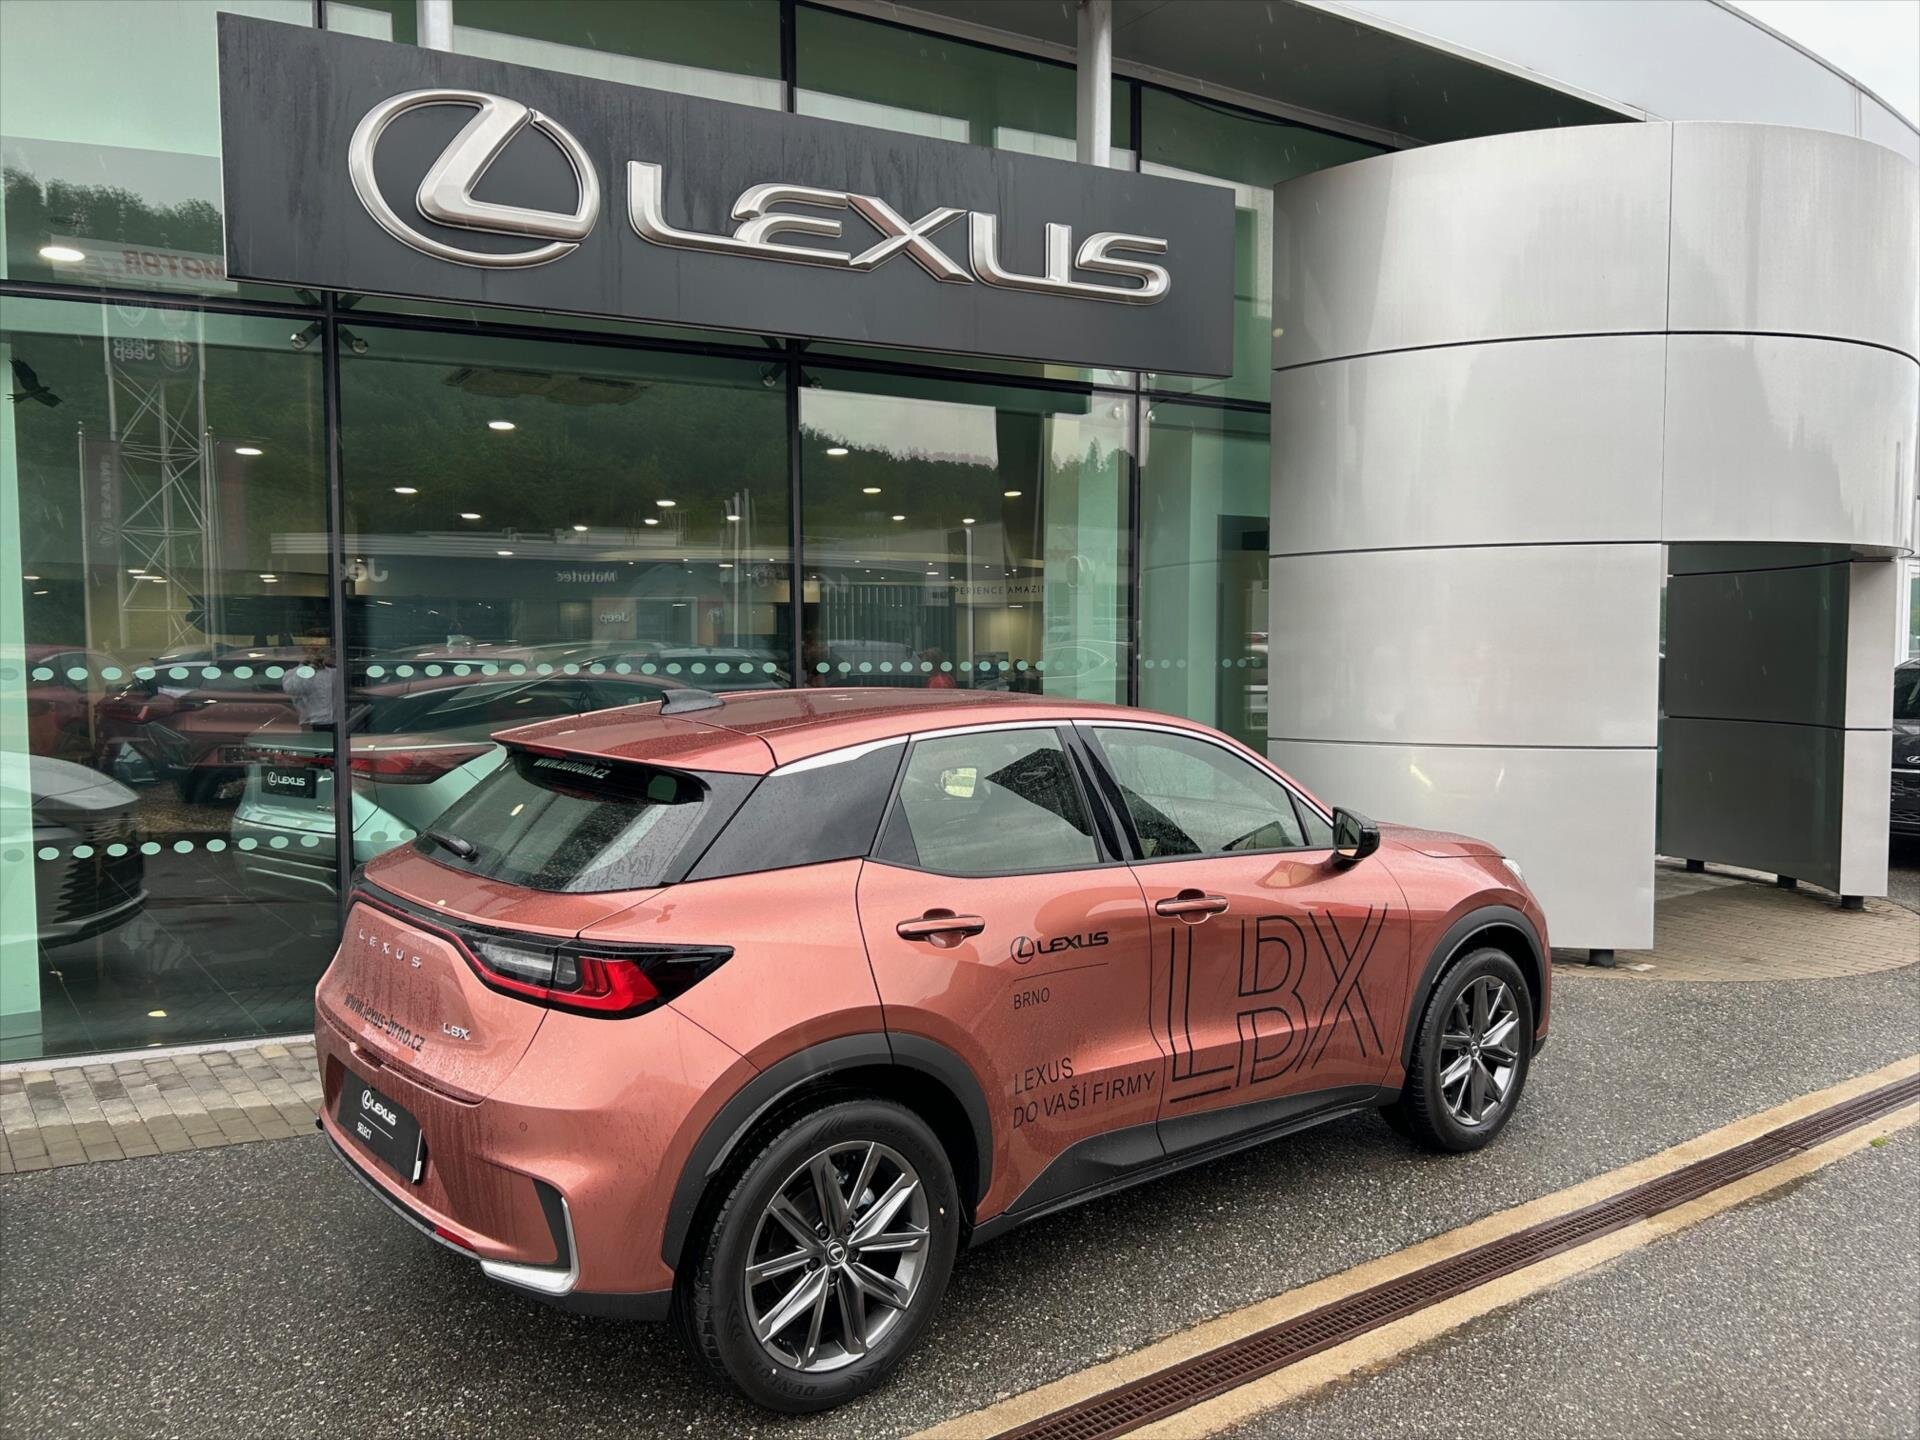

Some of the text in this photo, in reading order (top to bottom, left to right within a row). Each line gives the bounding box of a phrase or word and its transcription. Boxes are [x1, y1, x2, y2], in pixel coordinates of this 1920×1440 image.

[627, 160, 1172, 306] LEXUS
[952, 586, 1004, 596] PERIENCE
[277, 776, 306, 787] LEXUS
[359, 928, 422, 969] LEXUS
[1037, 931, 1109, 954] LEXUS
[1013, 987, 1051, 1010] BRNO
[1169, 903, 1389, 1103] LBX
[344, 991, 426, 1052] www.lexus-brno.cz
[443, 1022, 471, 1041] LBX
[1014, 1056, 1074, 1096] LEXUS
[370, 1098, 397, 1126] LEXUS
[1013, 1070, 1156, 1129] DO VAŠÍ FIRMY
